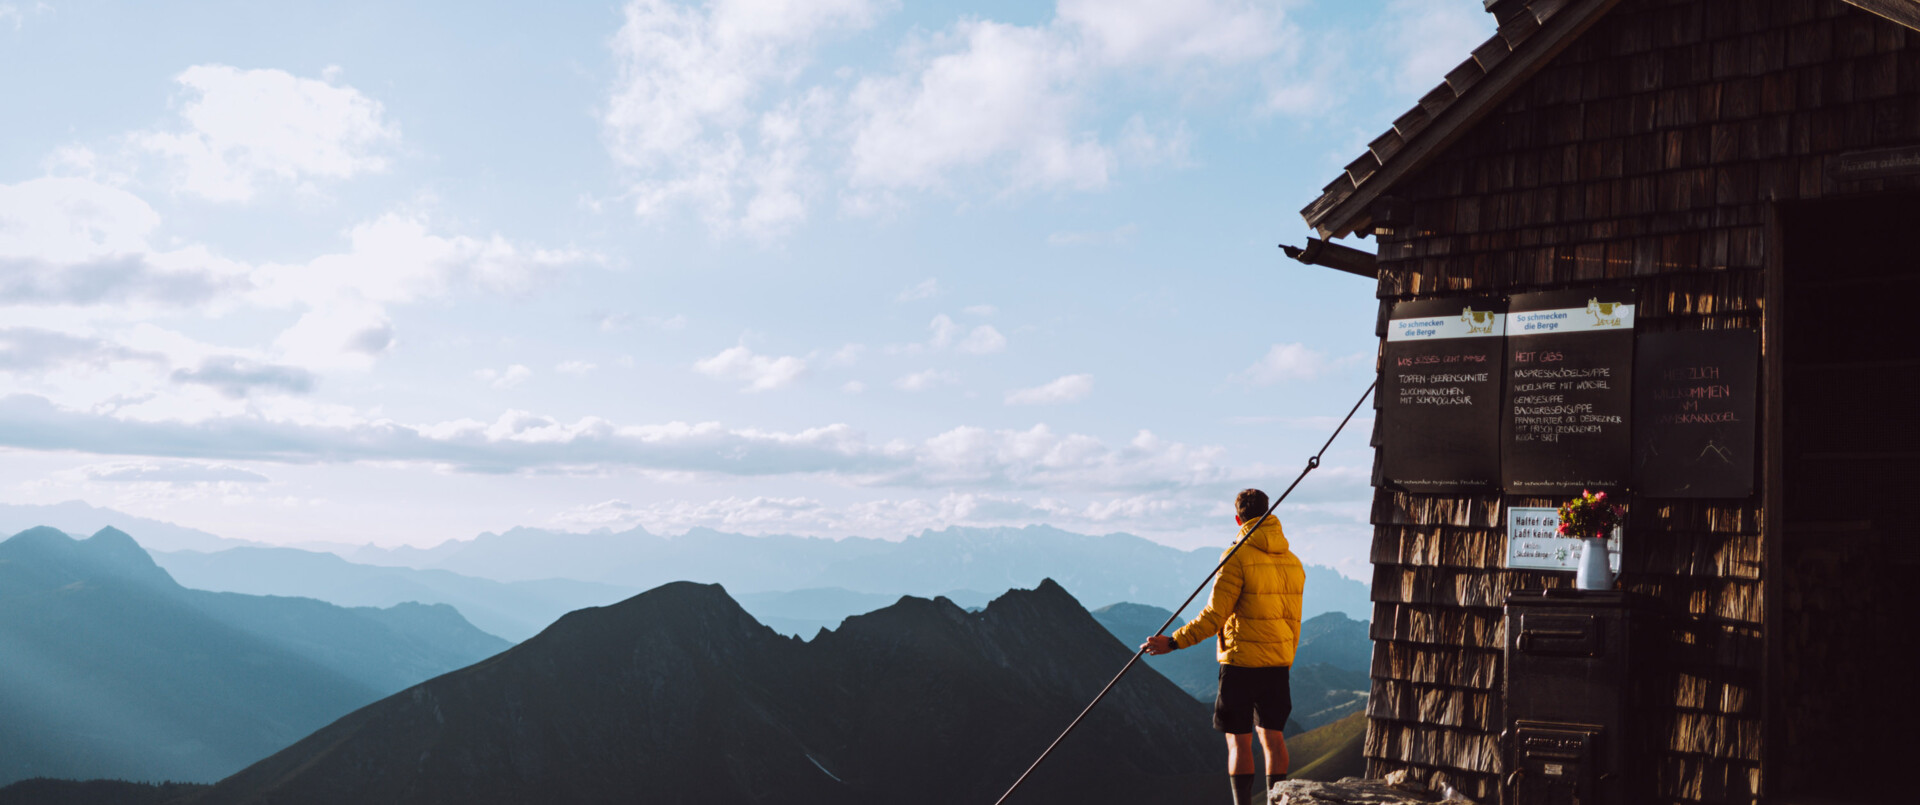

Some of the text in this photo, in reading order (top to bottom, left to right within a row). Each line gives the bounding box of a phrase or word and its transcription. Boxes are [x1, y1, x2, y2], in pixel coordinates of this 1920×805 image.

[1527, 312, 1568, 321] schmecken
[1408, 320, 1444, 328] schmecken
[1524, 321, 1558, 331] die Berge
[1405, 328, 1436, 337] die Berge
[1515, 351, 1536, 363] HEIT
[1560, 381, 1574, 391] MIT
[1654, 384, 1730, 399] WILLKOMMEN
[1516, 516, 1540, 526] Haltet
[1542, 517, 1554, 526] die
[1533, 528, 1552, 539] keine
